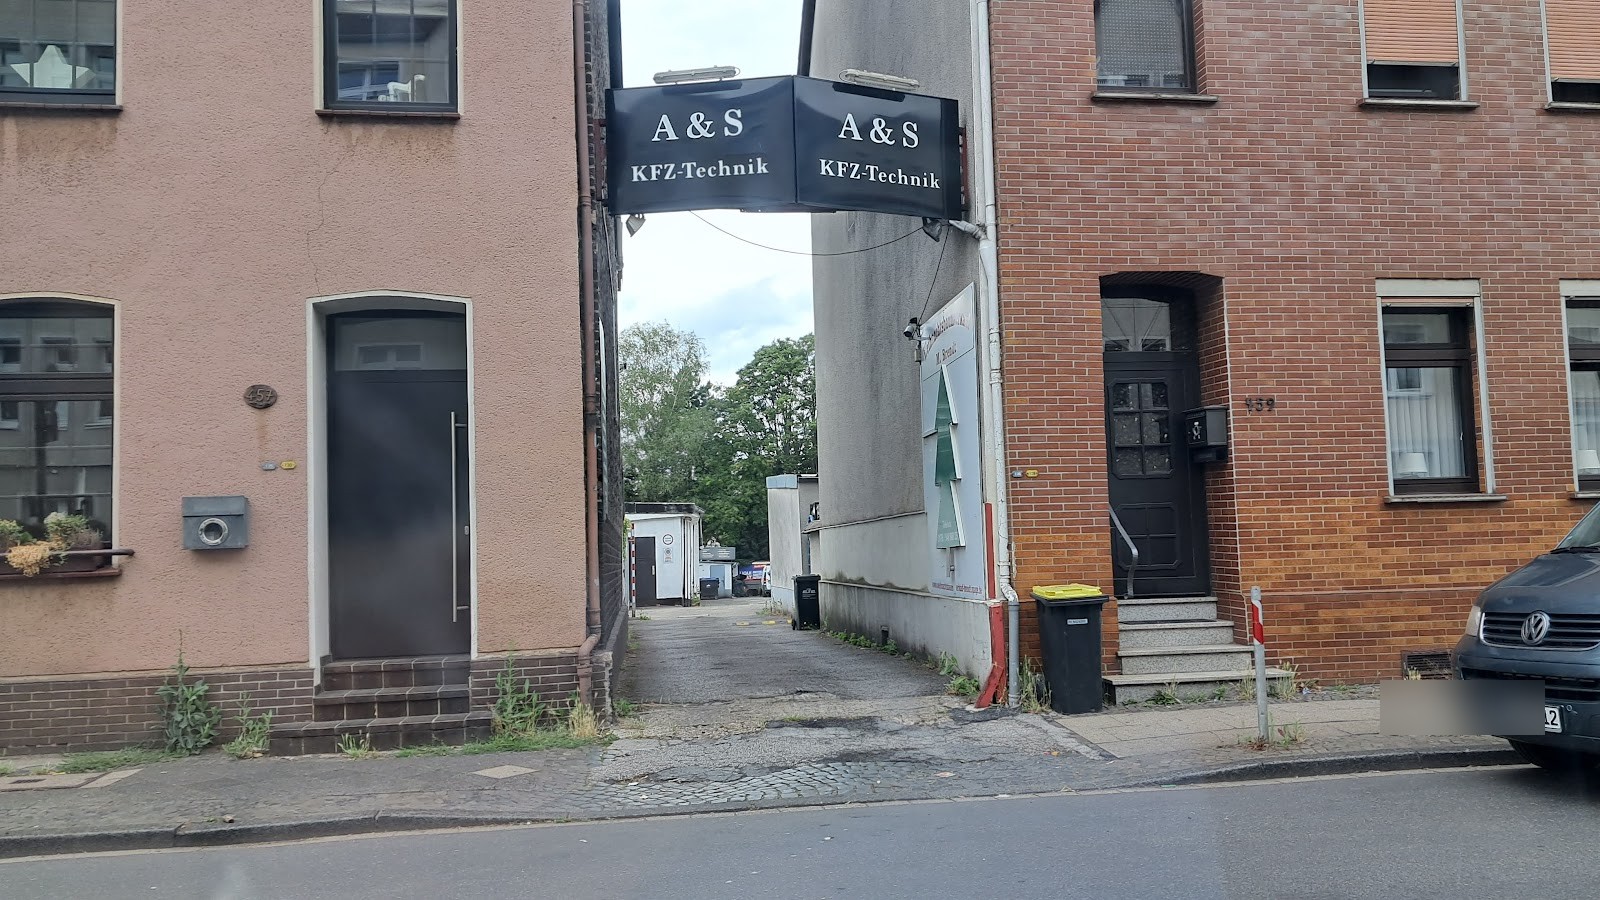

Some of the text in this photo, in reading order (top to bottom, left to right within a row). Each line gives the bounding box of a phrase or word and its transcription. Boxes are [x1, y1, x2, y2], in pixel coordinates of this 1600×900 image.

[652, 109, 743, 142] A & S
[838, 112, 919, 148] A & S
[631, 157, 769, 182] KFZ-Technik
[819, 158, 941, 189] KFZ-Technik
[246, 388, 273, 402] 457
